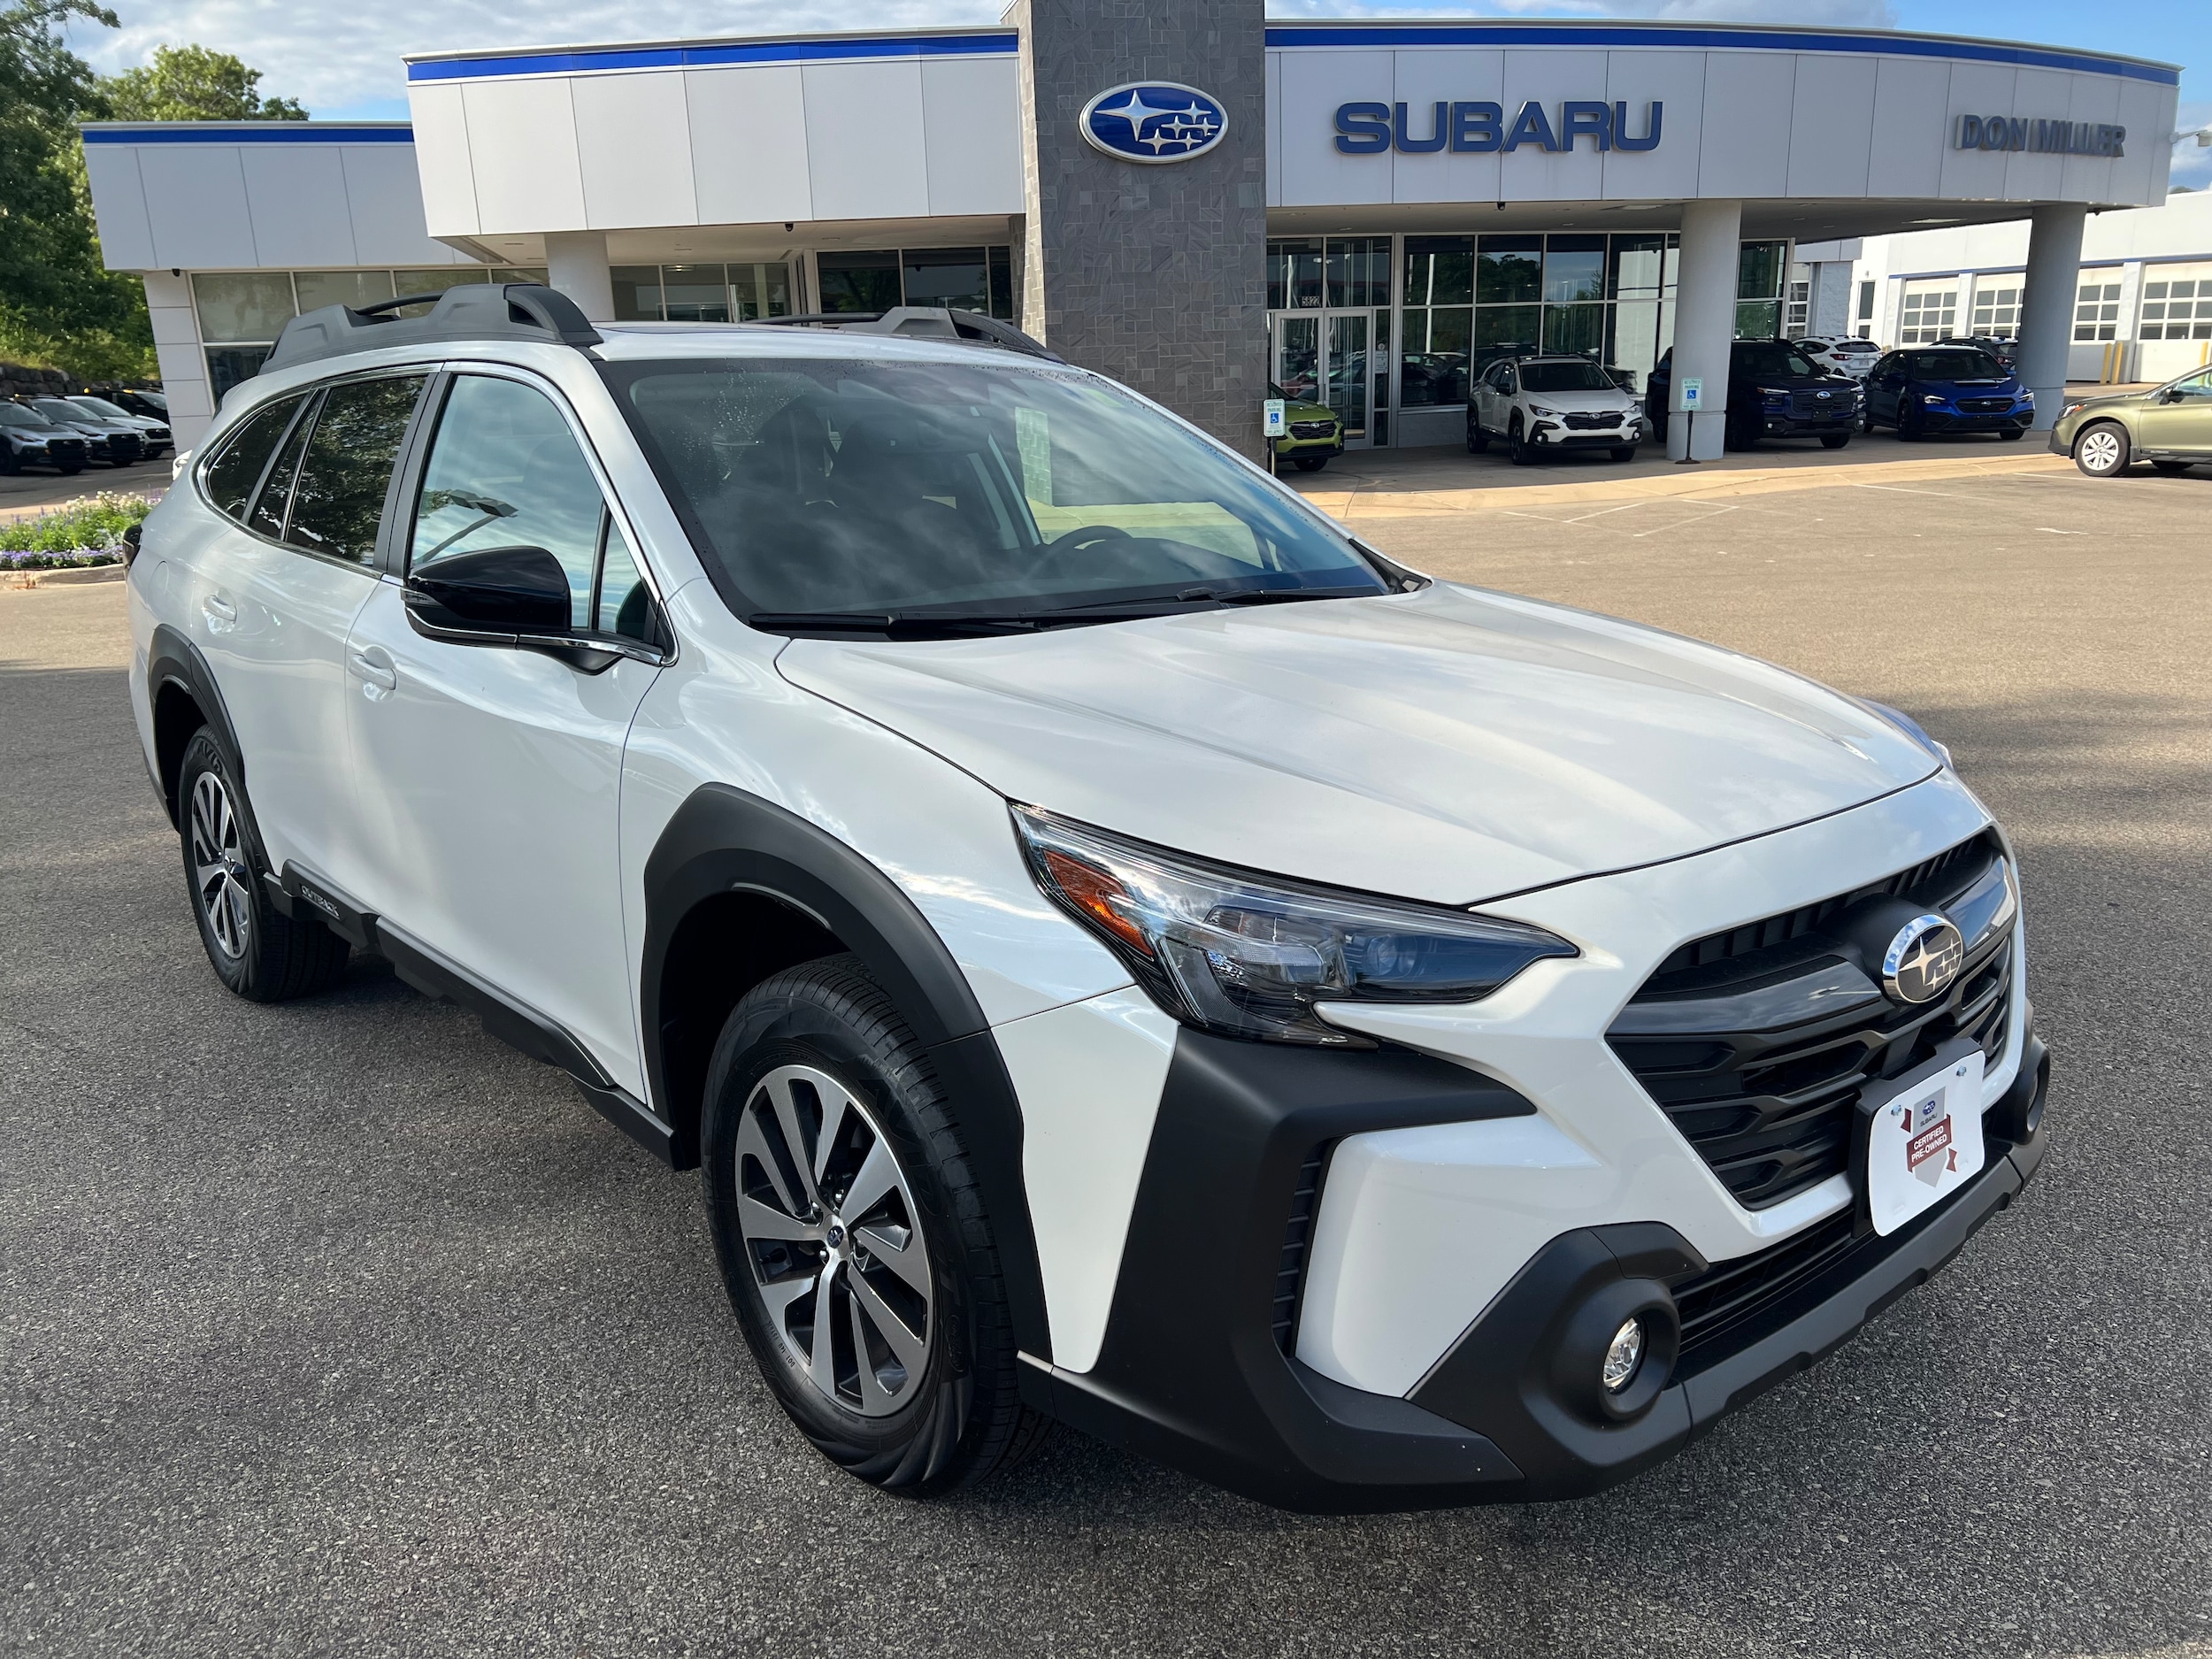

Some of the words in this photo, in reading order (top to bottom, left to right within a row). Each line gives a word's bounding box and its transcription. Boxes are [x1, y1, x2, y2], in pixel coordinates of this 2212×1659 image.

[1334, 101, 1663, 153] SUBARU
[1956, 114, 2028, 151] DON
[2033, 119, 2126, 157] MILLER
[1302, 296, 1319, 306] 5822
[301, 885, 340, 917] OUTBACK
[1920, 1113, 1938, 1126] SUBARU
[1911, 1133, 1947, 1163] PRE-OWNED
[1914, 1125, 1944, 1150] CERTIFIED
